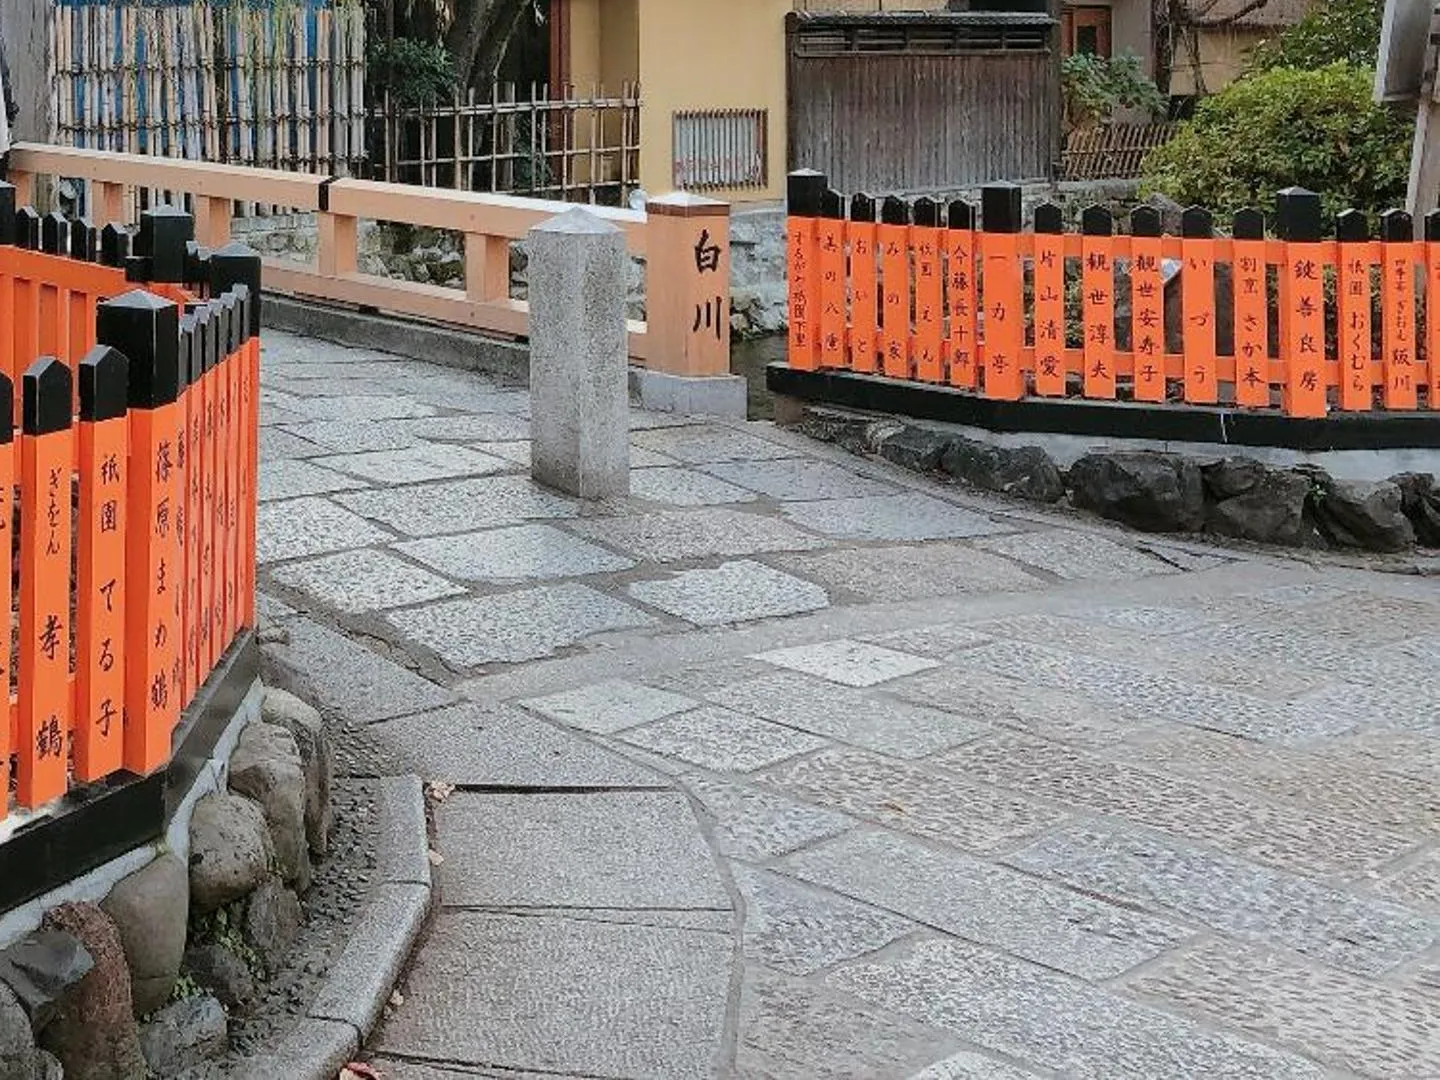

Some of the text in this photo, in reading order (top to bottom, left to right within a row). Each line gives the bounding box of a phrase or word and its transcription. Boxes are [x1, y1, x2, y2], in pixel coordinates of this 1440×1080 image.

[693, 229, 722, 341] 白川
[951, 245, 970, 368] 今藤長十郎
[989, 255, 1011, 375] 一力亭
[1039, 250, 1060, 378] 片山清愛
[1087, 252, 1111, 380] 観世淳夫
[1136, 254, 1160, 382] 観世安寿子
[1189, 257, 1209, 384] いづう
[1294, 259, 1320, 393] 鍵善良房
[1242, 315, 1265, 389] さか本
[1349, 311, 1366, 392] おくむら
[94, 453, 121, 738] 祇園 てる子
